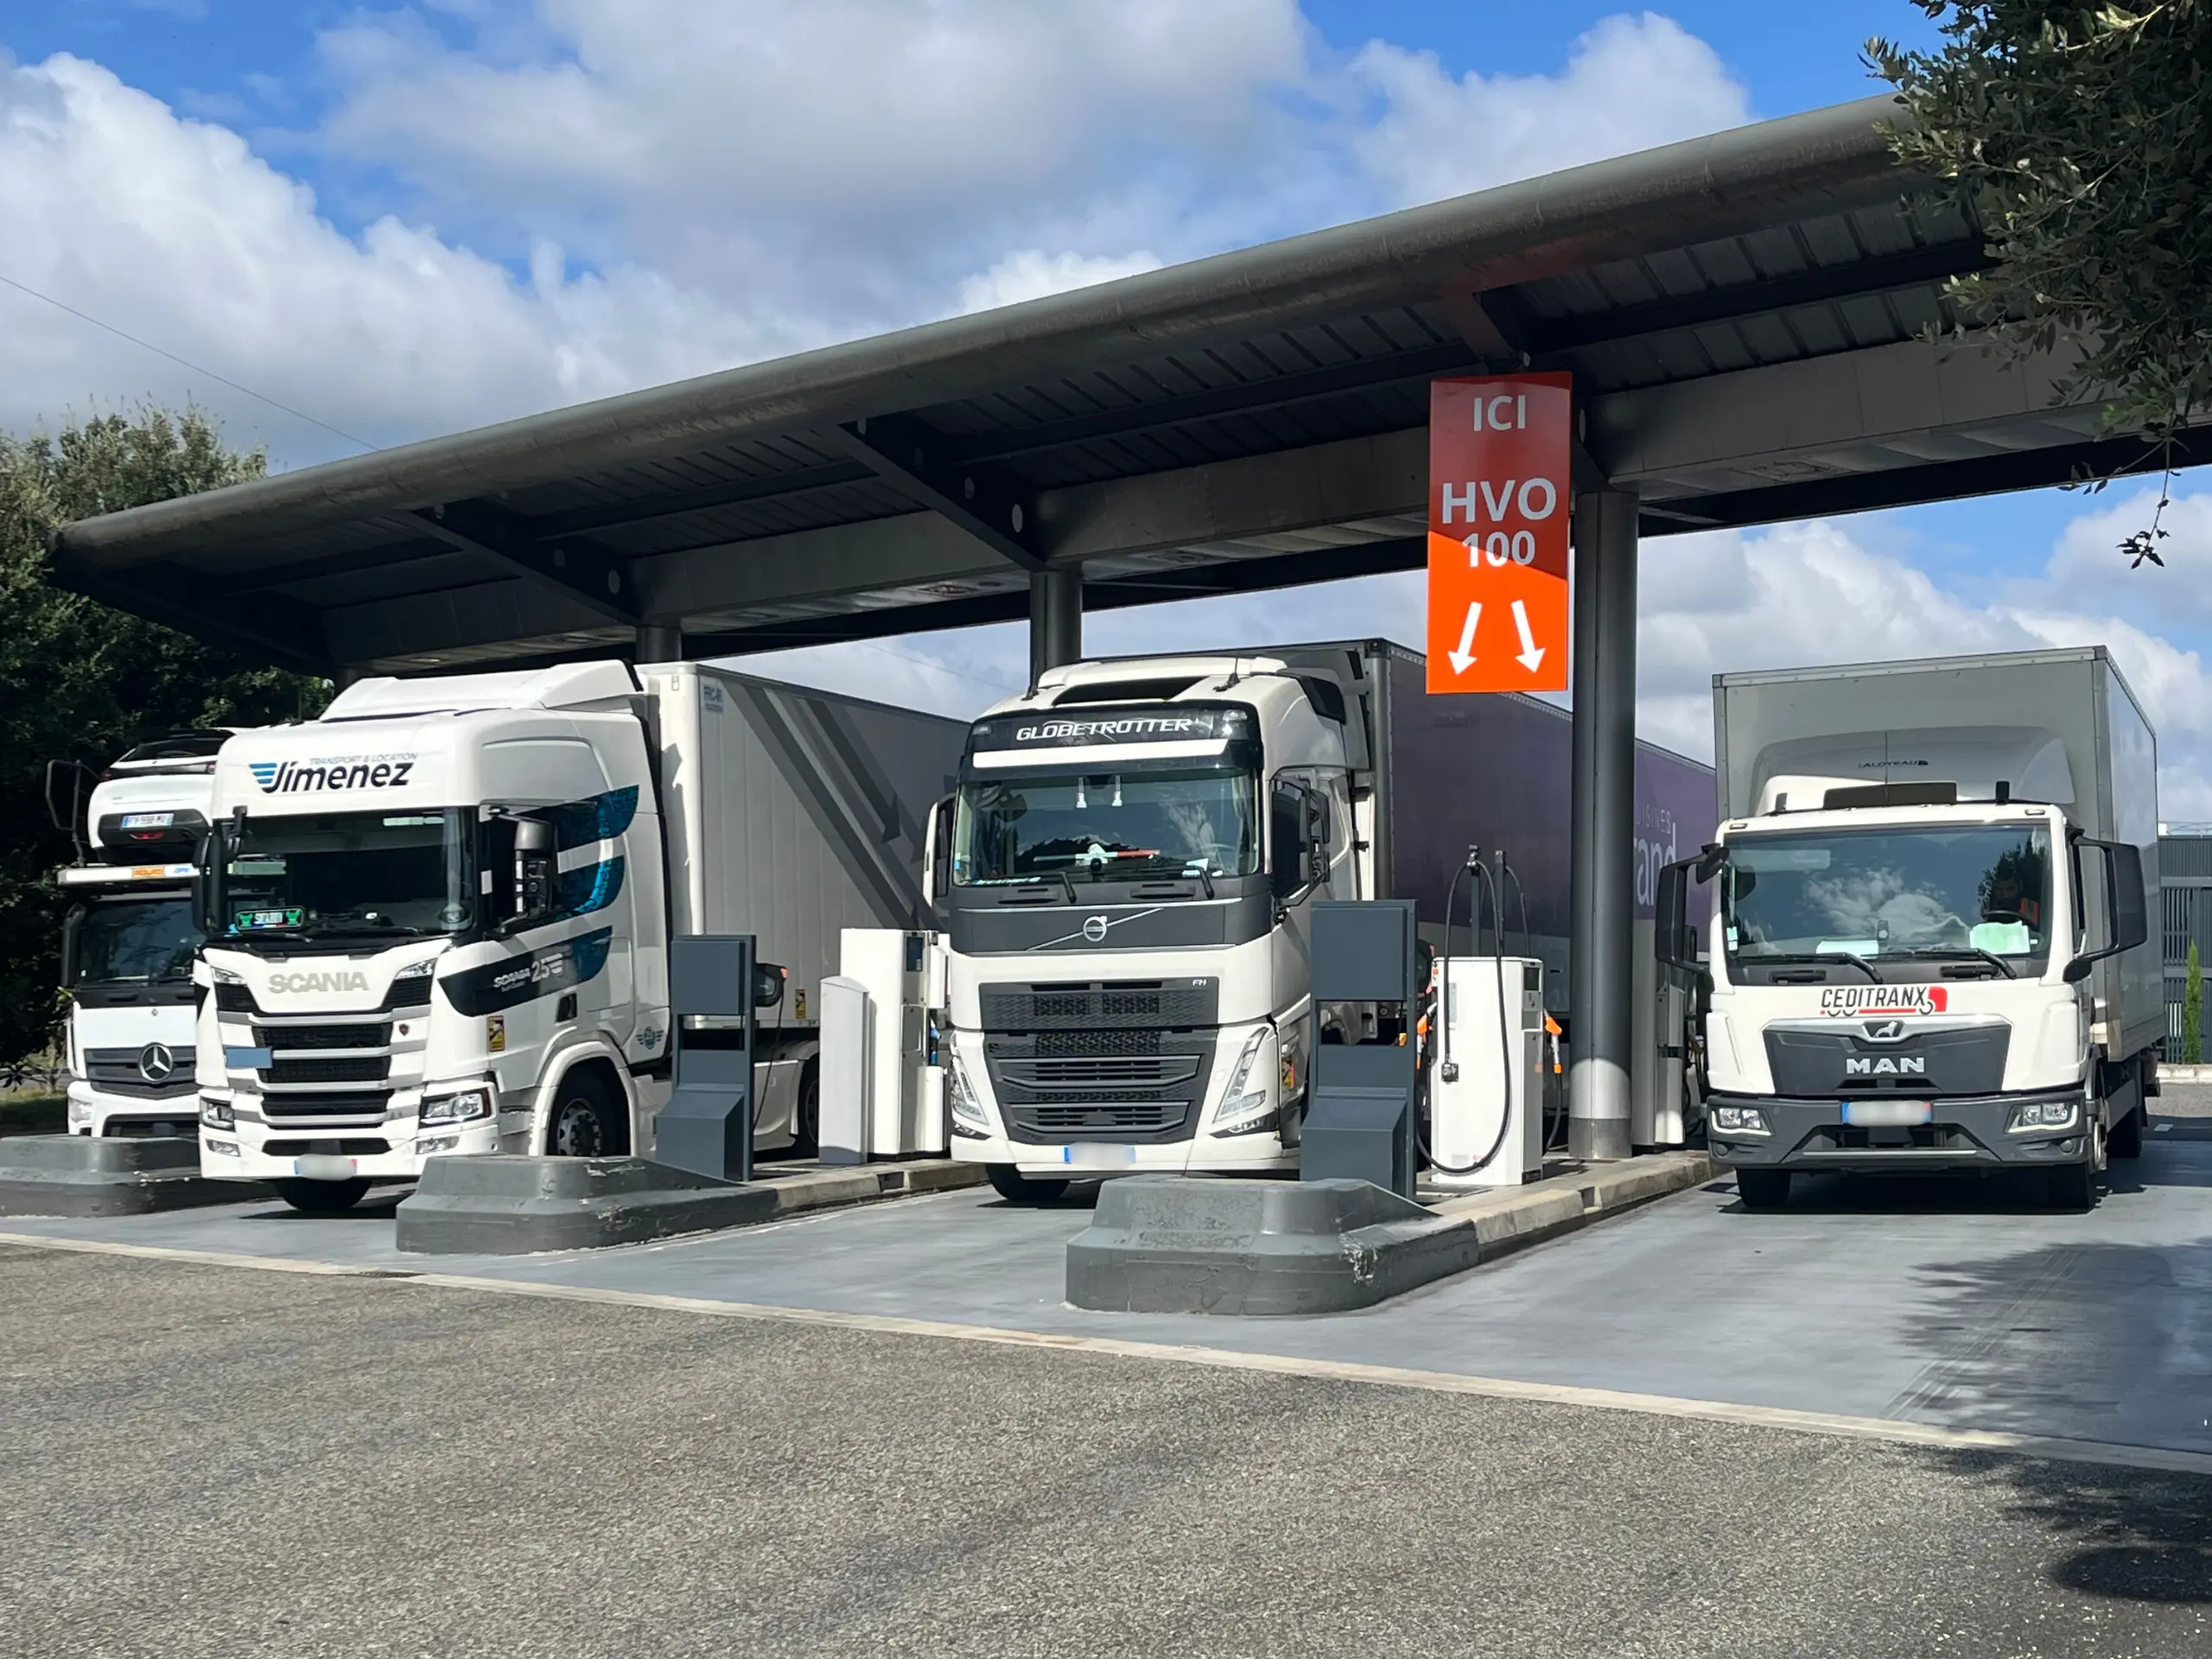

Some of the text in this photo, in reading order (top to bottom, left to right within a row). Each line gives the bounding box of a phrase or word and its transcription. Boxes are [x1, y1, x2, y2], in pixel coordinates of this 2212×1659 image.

[1472, 394, 1526, 432] ICI
[1441, 477, 1557, 524] HVO
[1461, 530, 1536, 568] 100
[1016, 718, 1193, 741] GLOBETROTTER
[308, 754, 361, 766] TRANSPORT
[371, 753, 418, 763] LOCATION
[261, 760, 415, 794] Jimenez
[1634, 800, 1672, 835] UISINES
[269, 972, 370, 994] SCANIA
[1821, 987, 1927, 1007] CEDITRANX
[1846, 1057, 1925, 1074] MAN
